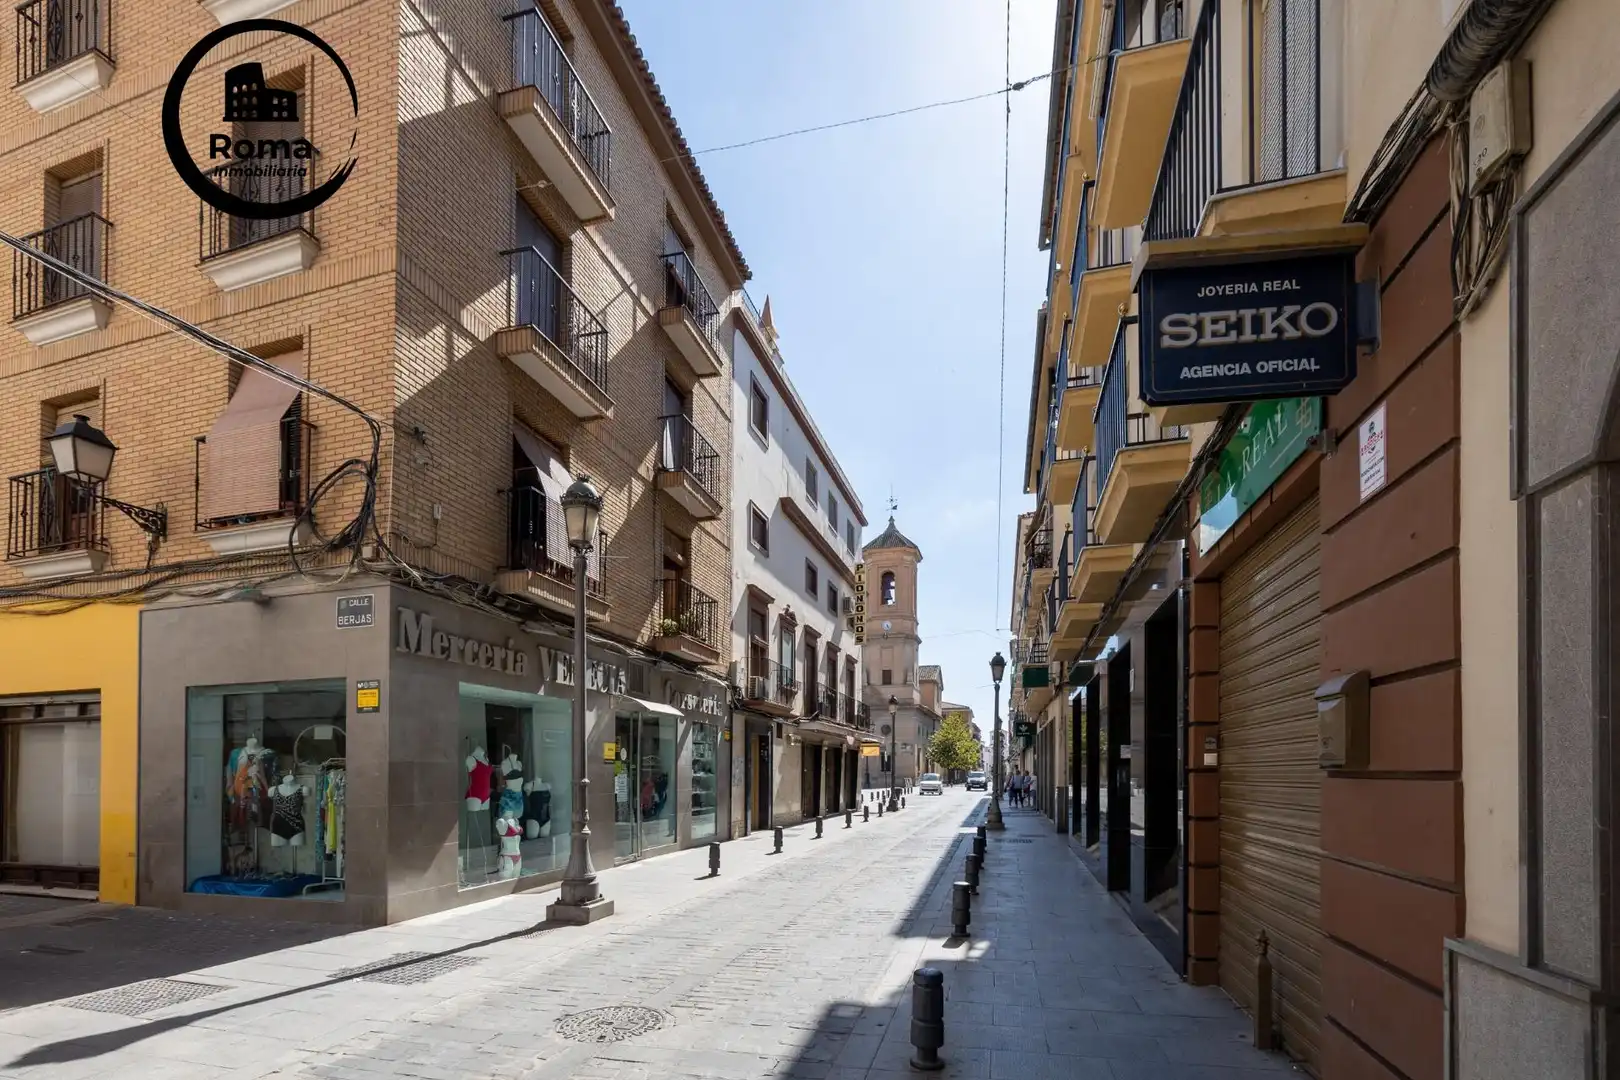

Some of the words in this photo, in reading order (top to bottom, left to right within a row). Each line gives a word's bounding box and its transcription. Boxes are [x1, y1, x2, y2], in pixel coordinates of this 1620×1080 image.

[1197, 282, 1259, 298] JOYERIA
[1263, 279, 1301, 292] REAL
[1159, 302, 1339, 349] SEIKO
[1180, 362, 1252, 379] AGENCIA
[1256, 358, 1320, 373] OFICIAL
[1242, 402, 1288, 480] REAL
[349, 598, 370, 607] CALLE
[855, 563, 865, 643] PIONONOS
[338, 613, 372, 625] BERJAS
